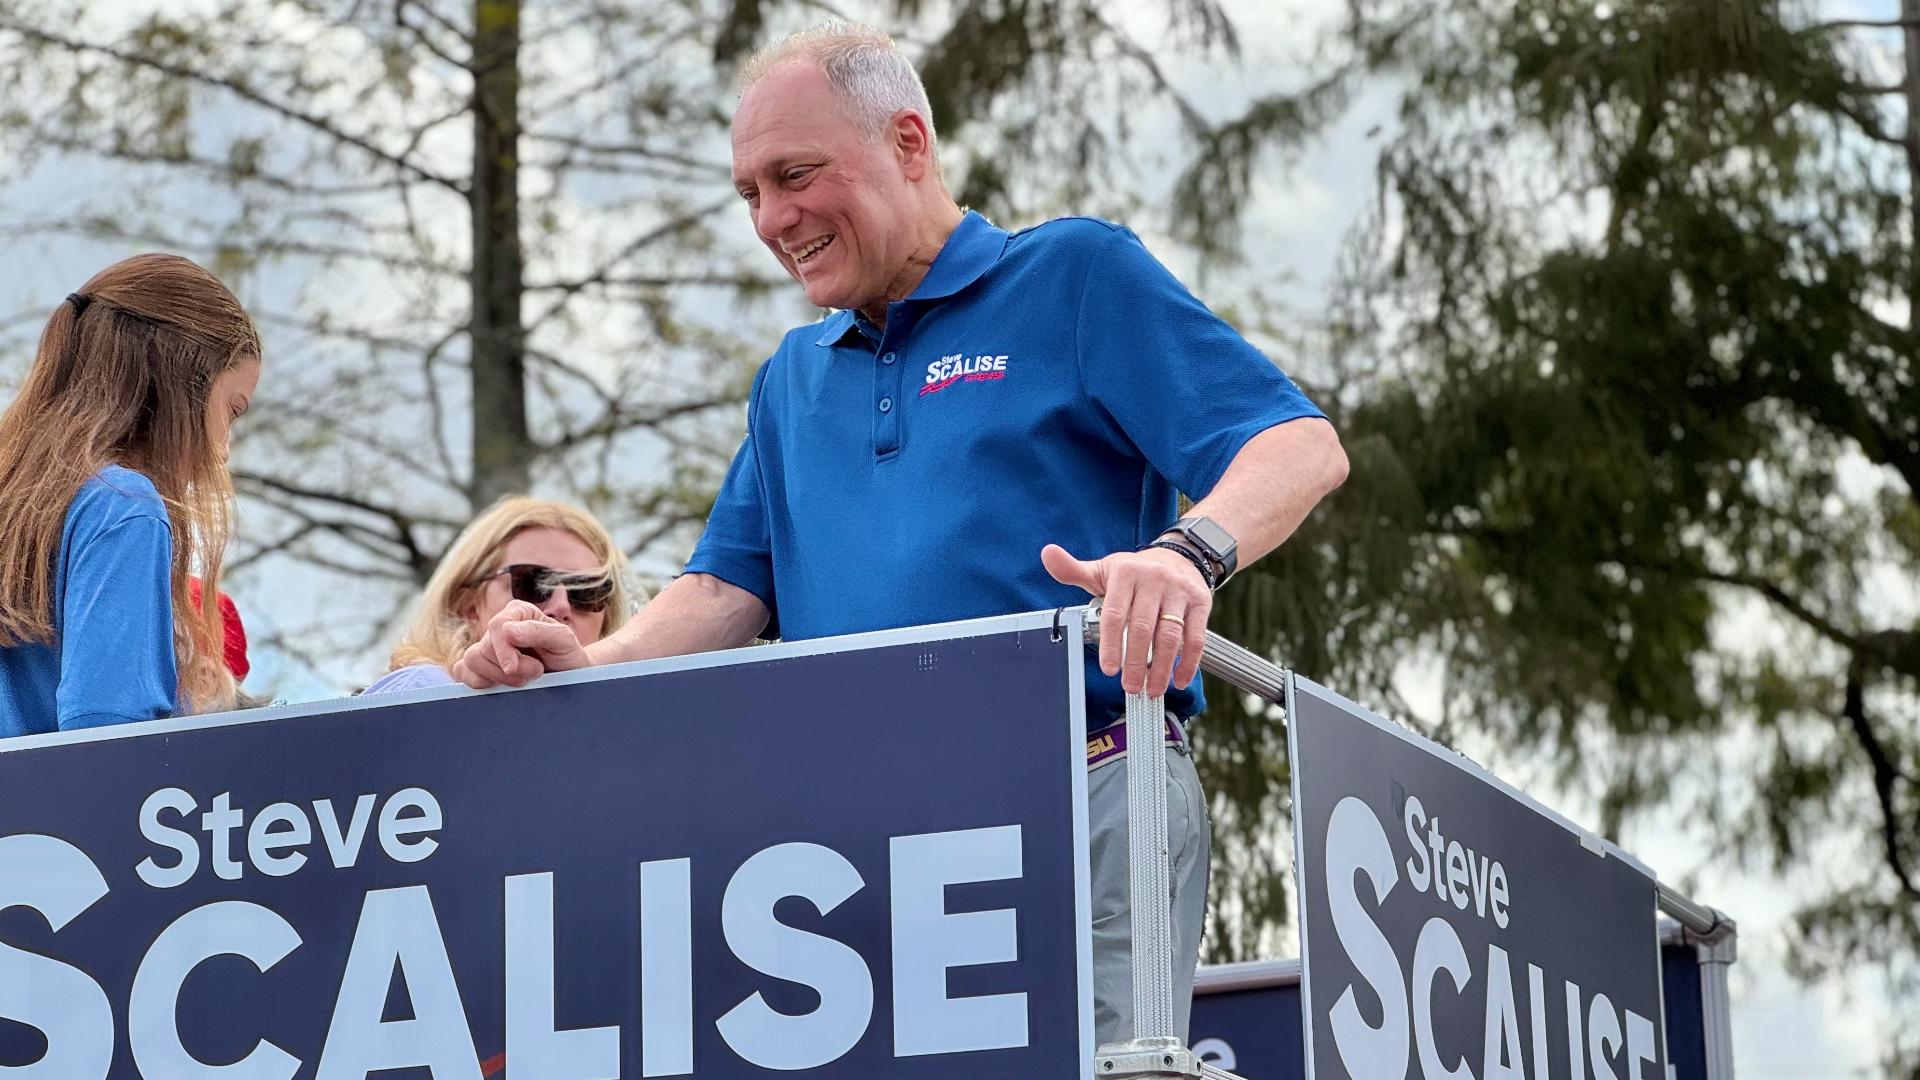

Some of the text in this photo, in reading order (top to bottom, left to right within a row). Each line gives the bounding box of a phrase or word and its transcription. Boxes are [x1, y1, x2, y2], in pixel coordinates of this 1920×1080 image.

[925, 355, 1009, 384] SCALISE
[1087, 734, 1116, 759] SU
[135, 787, 443, 888] Steve
[1405, 796, 1510, 929] Steve
[0, 824, 1029, 1080] SCALISE
